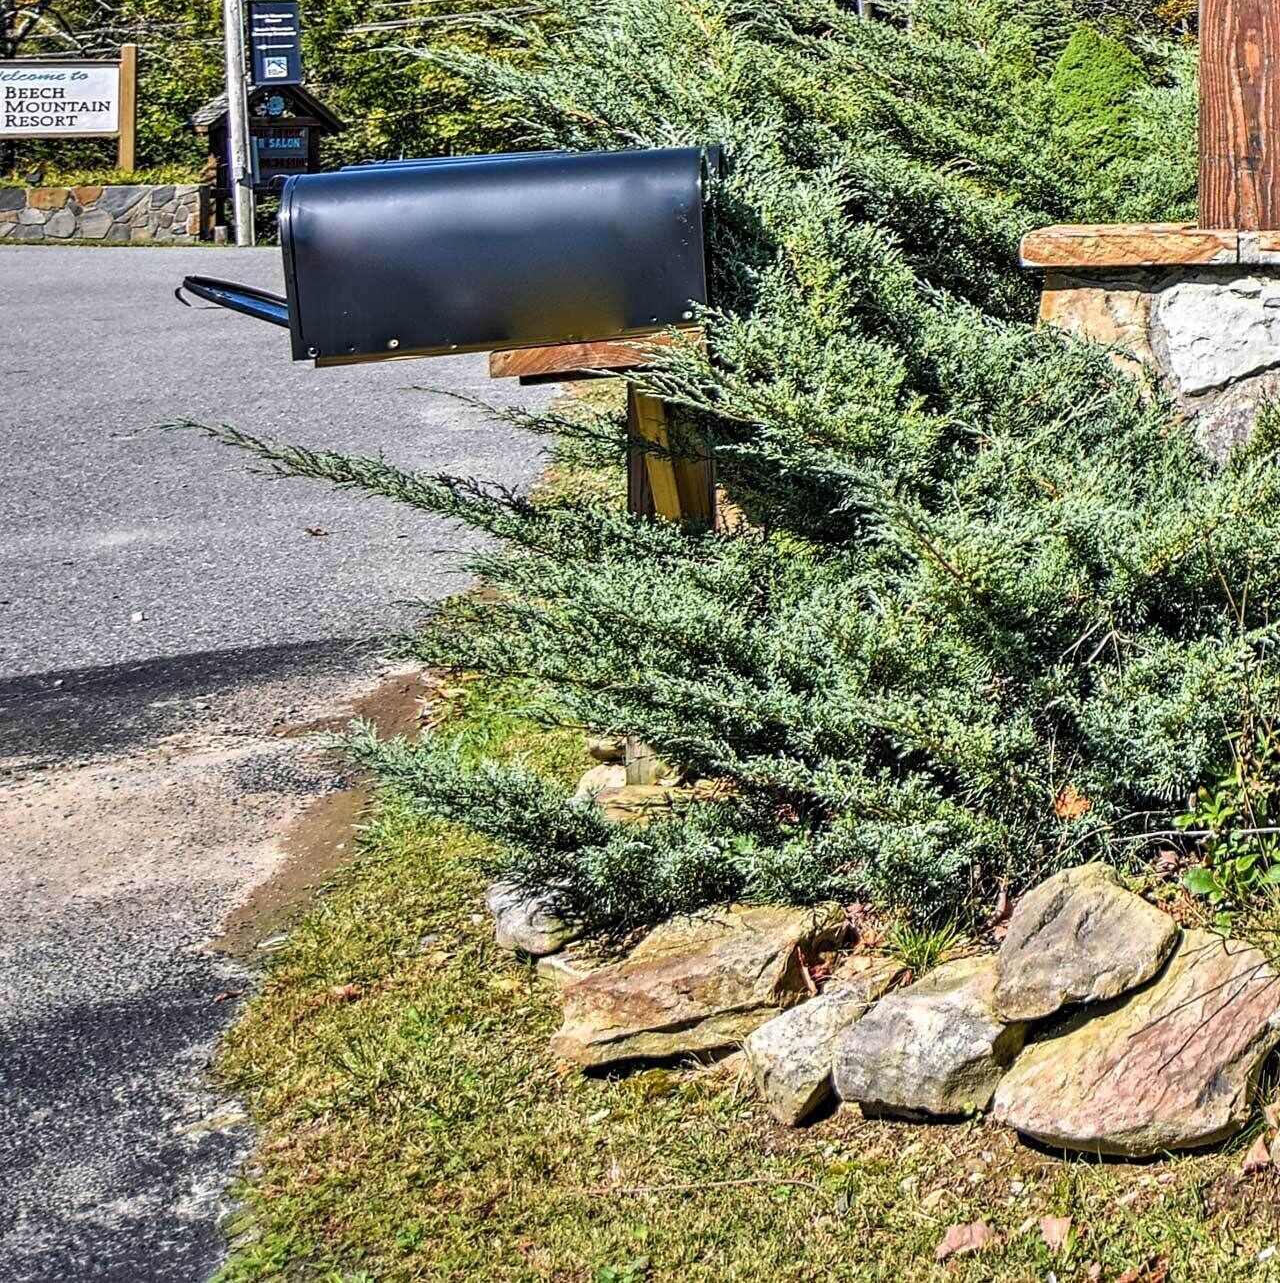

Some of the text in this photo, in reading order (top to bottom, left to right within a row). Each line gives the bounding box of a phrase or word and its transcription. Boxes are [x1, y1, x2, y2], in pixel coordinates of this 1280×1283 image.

[69, 71, 89, 81] to
[4, 86, 65, 99] BEECH
[4, 100, 112, 114] MOUNTAIN
[4, 114, 79, 127] RESORT
[268, 137, 301, 149] SALON
